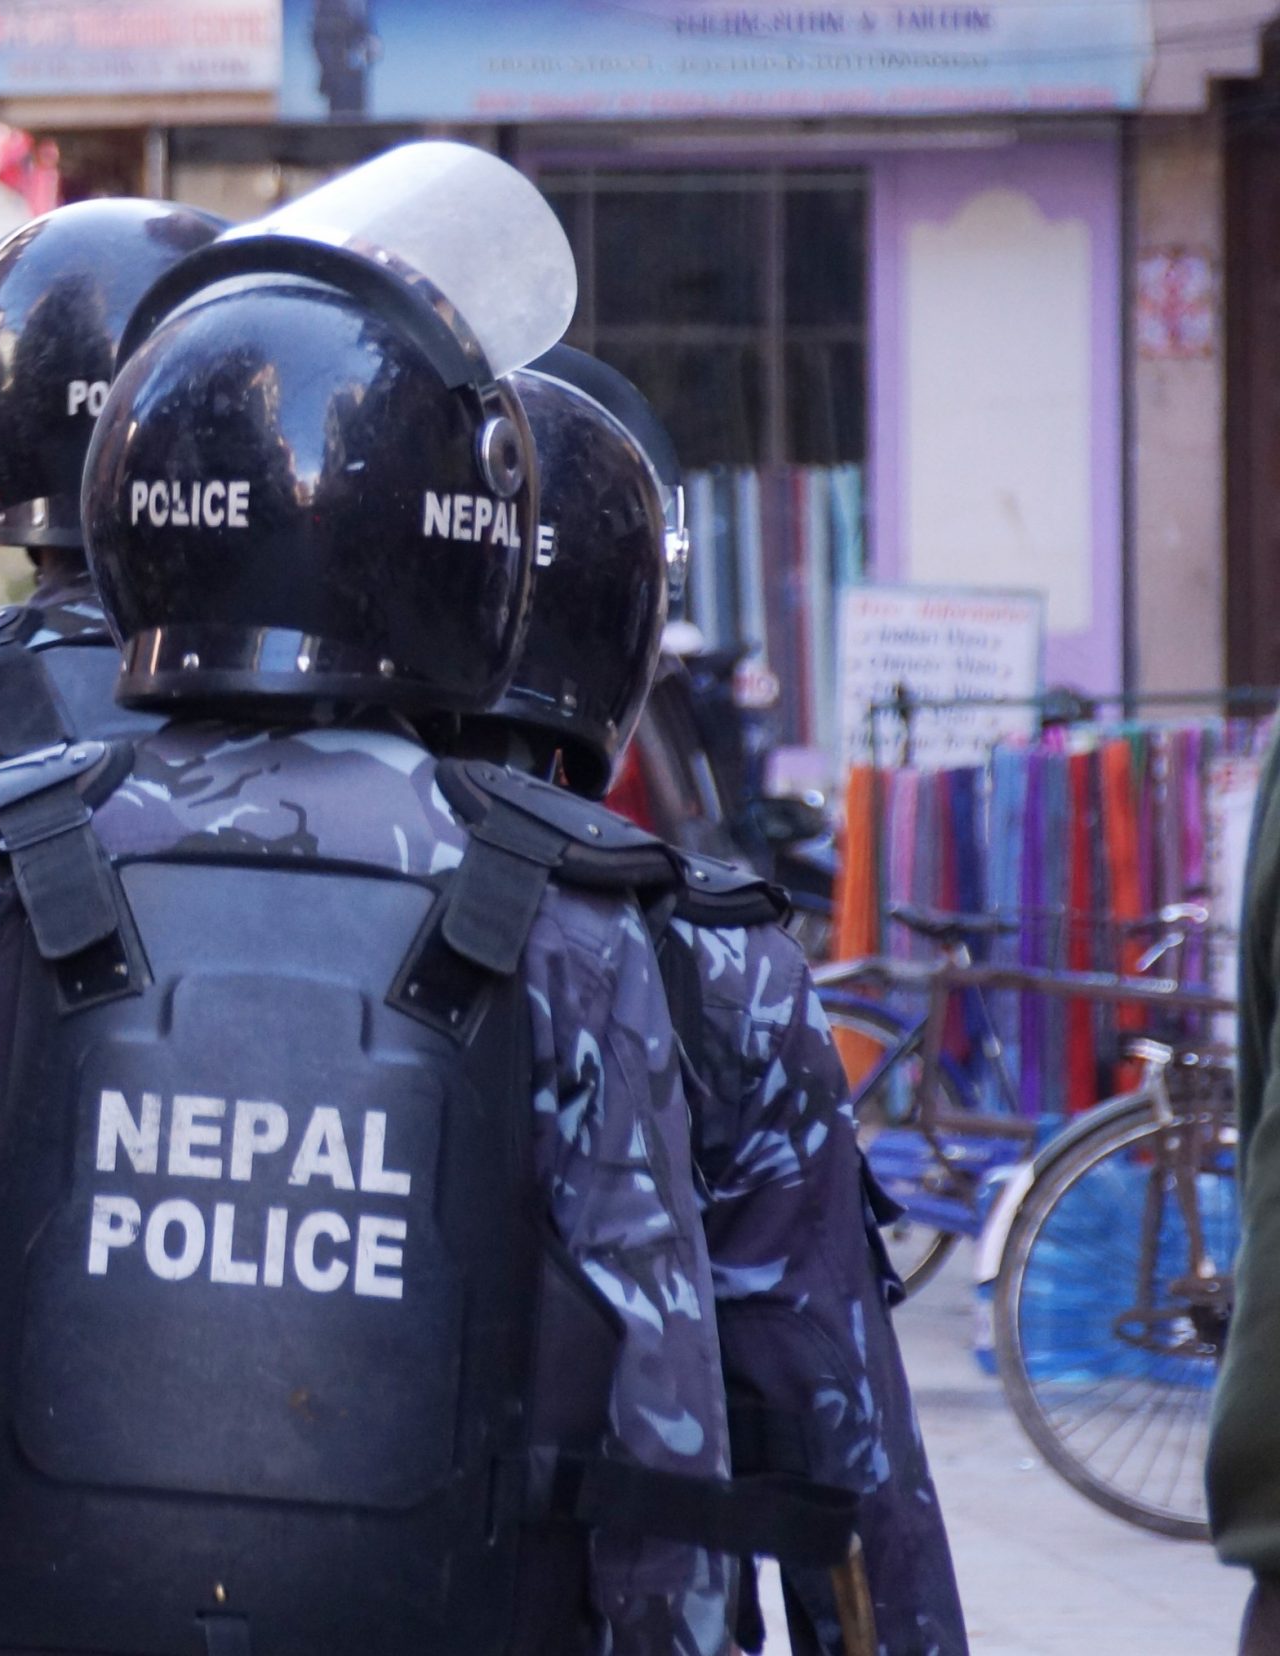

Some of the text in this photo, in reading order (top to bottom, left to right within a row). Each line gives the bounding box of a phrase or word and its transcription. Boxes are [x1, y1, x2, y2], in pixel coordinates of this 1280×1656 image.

[131, 479, 250, 527] POLICE
[423, 489, 521, 549] NEPAL
[96, 1089, 411, 1195] NEPAL
[87, 1195, 407, 1299] POLICE
